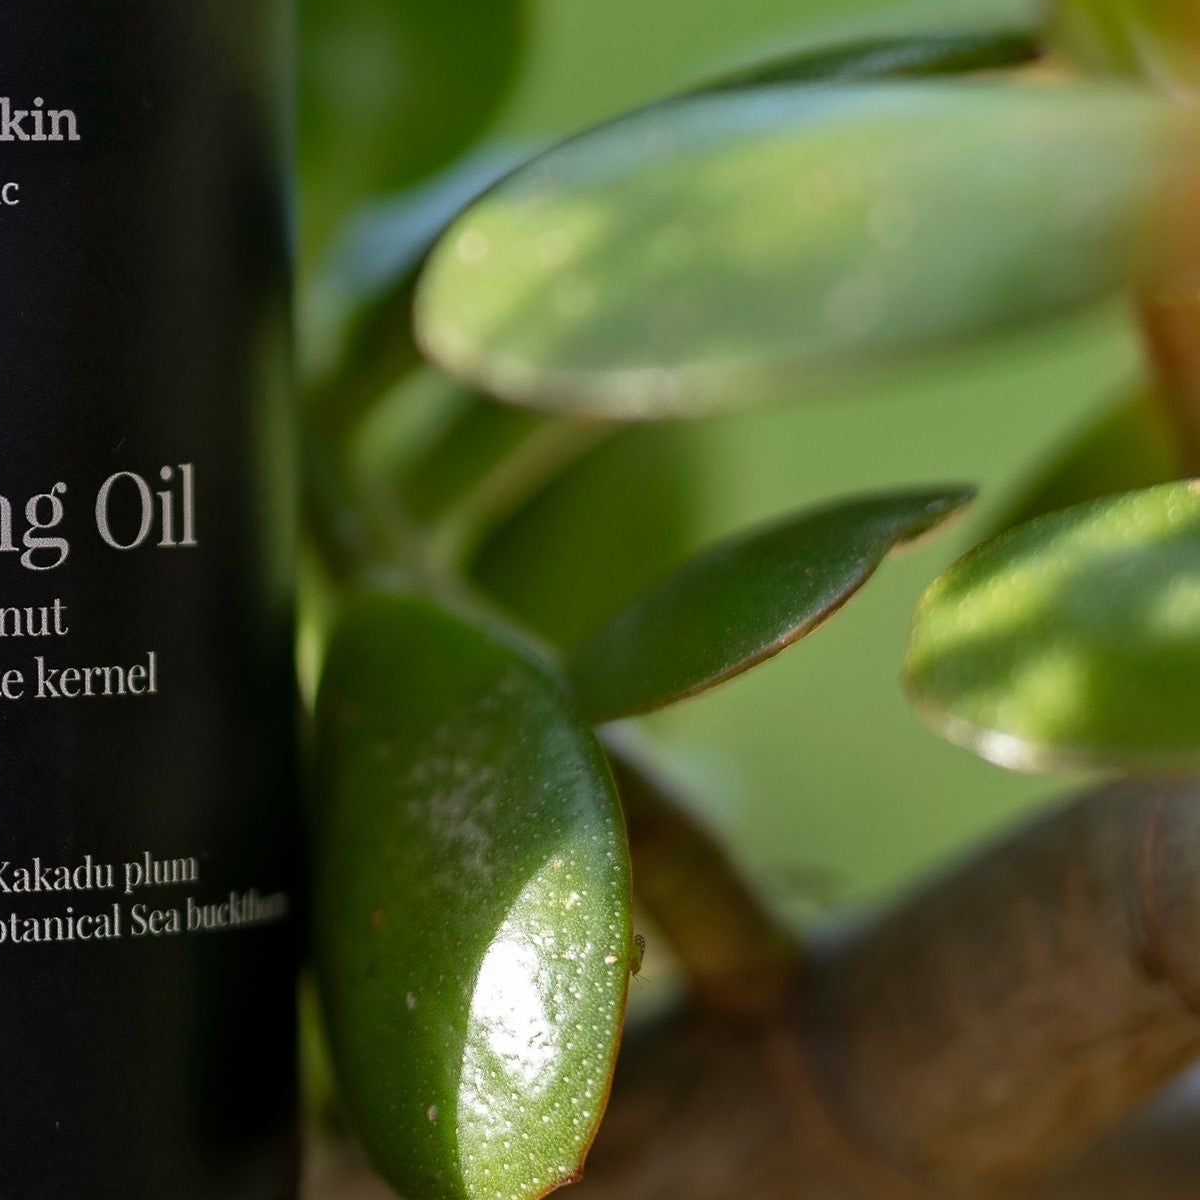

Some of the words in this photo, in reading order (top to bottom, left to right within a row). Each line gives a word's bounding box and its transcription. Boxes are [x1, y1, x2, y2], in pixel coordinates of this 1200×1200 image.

[95, 463, 198, 550] Oil
[35, 652, 159, 700] kernel
[123, 851, 201, 894] plum
[130, 903, 182, 938] Sea
